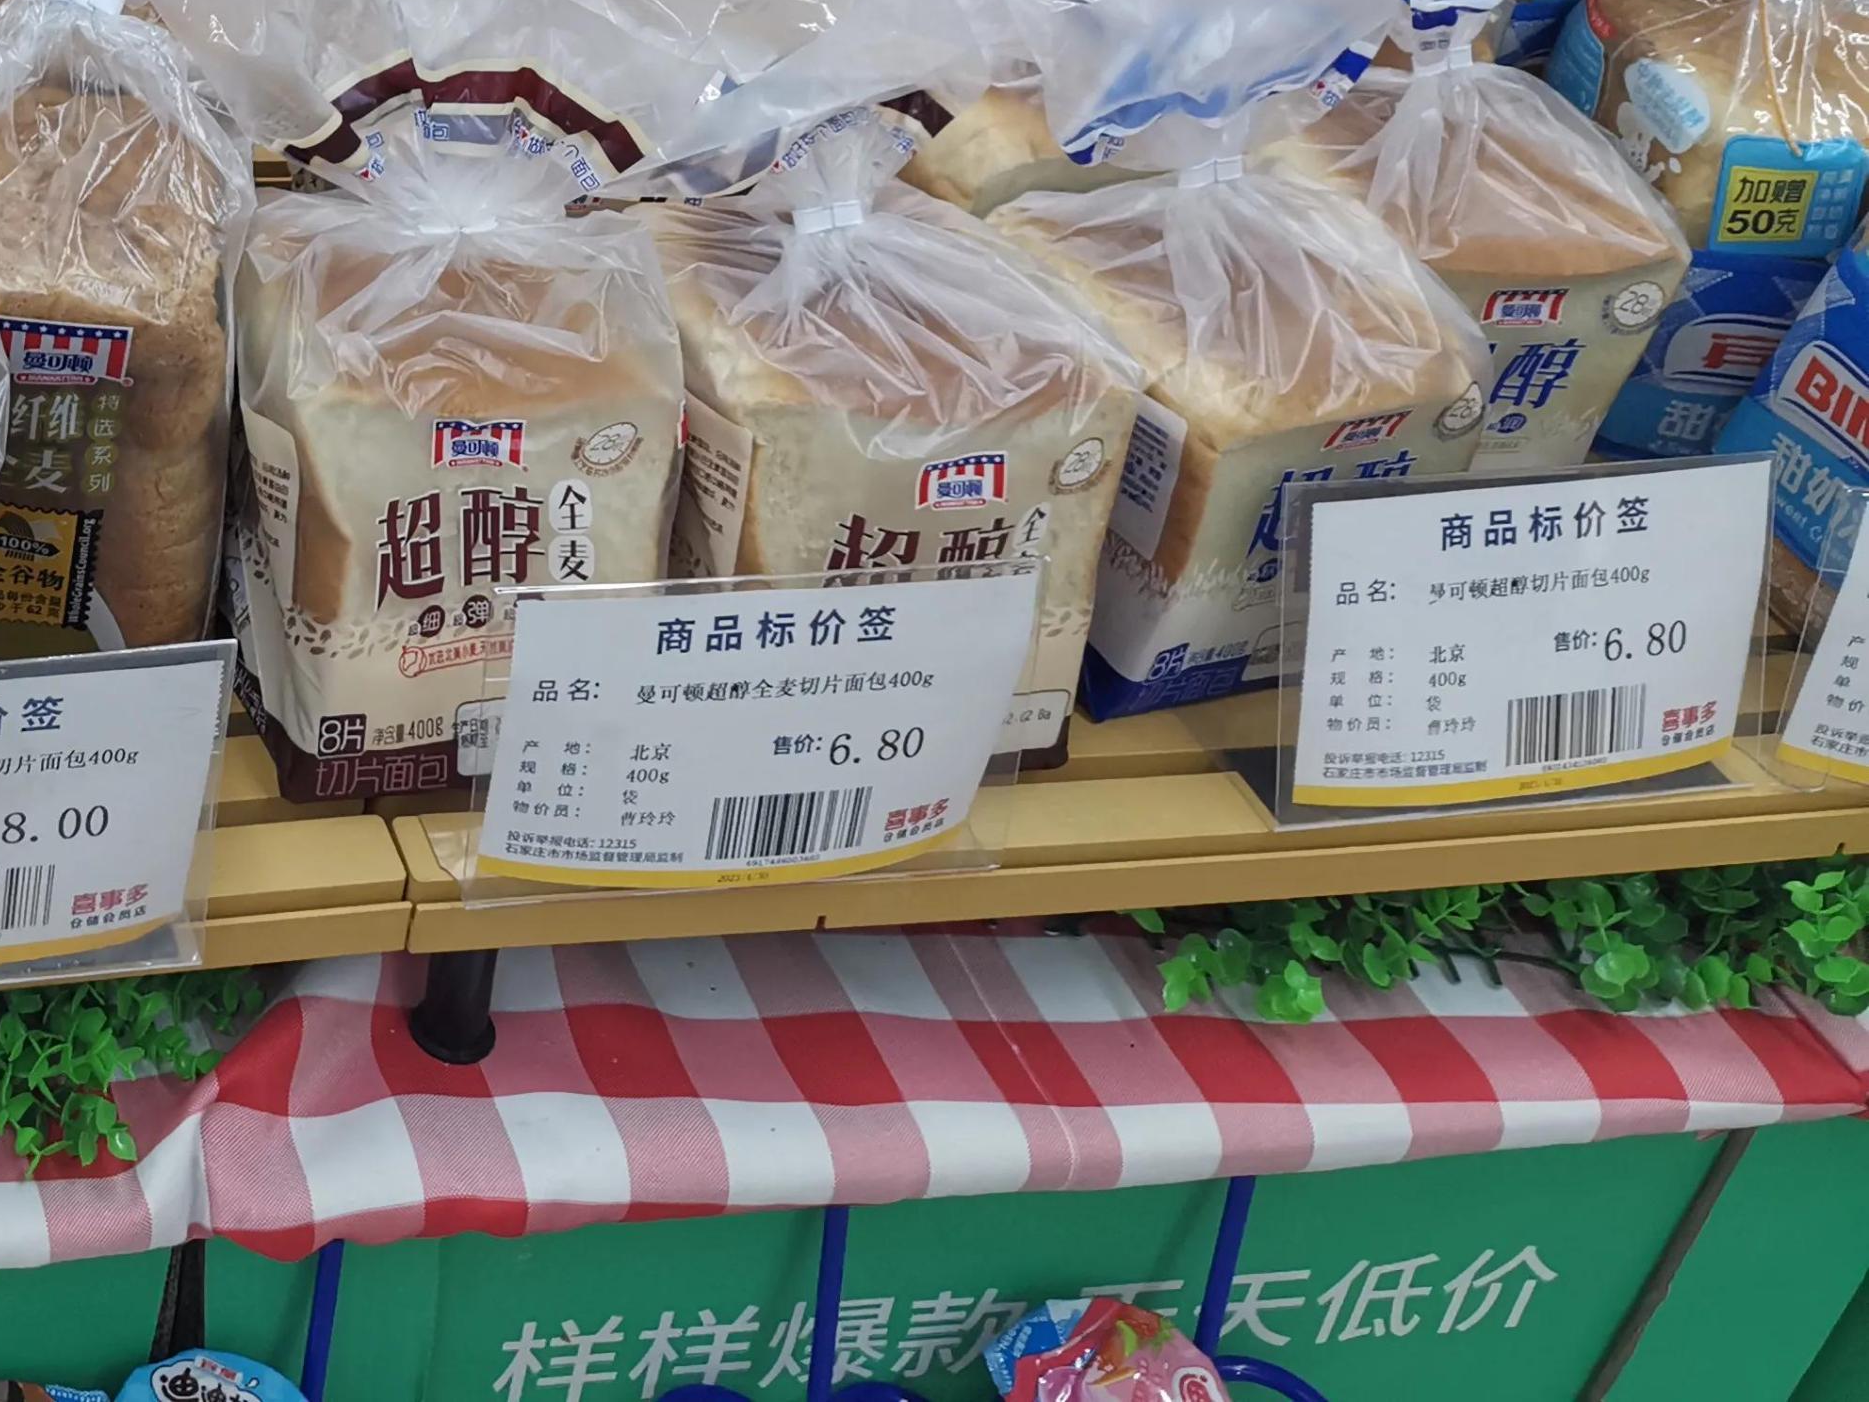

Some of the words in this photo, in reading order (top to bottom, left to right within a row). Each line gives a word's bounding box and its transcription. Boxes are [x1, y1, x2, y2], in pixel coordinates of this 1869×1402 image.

[1733, 176, 1808, 205] 加赠
[1726, 208, 1802, 236] 50克
[557, 484, 591, 582] 全麦
[1439, 496, 1650, 552] 商品标价签
[376, 485, 547, 614] 超醇
[1335, 579, 1397, 606] 品名：
[656, 605, 897, 656] 商品标价签
[1553, 629, 1598, 654] 售价：
[1603, 619, 1688, 662] 6.80
[1330, 645, 1395, 663] 产地：
[1429, 643, 1467, 664] 北京
[532, 678, 601, 704] 品名：
[636, 669, 935, 706] 曼可顿超醇全麦切片面包400g
[1330, 670, 1394, 687] 规格：
[1428, 671, 1467, 690] 400g
[1328, 692, 1394, 709] 单位：
[1660, 700, 1719, 734] 喜事多
[318, 718, 366, 755] 8片
[1326, 715, 1392, 733] 物价员：
[522, 739, 592, 756] 产地：
[630, 741, 672, 762] 北京
[772, 733, 824, 757] 售价：
[829, 726, 925, 766] 6.80
[316, 753, 449, 797] 切片面包
[515, 779, 586, 799] 单位：
[518, 759, 589, 778] 规格：
[626, 766, 670, 786] 400g
[0, 805, 111, 846] 8.00
[512, 800, 582, 819] 物价员：
[883, 797, 951, 832] 喜事多
[504, 843, 684, 864] 石家庄市市场监督管理局监制
[70, 882, 150, 917] 喜事多
[491, 1288, 1028, 1400] 样样爆款
